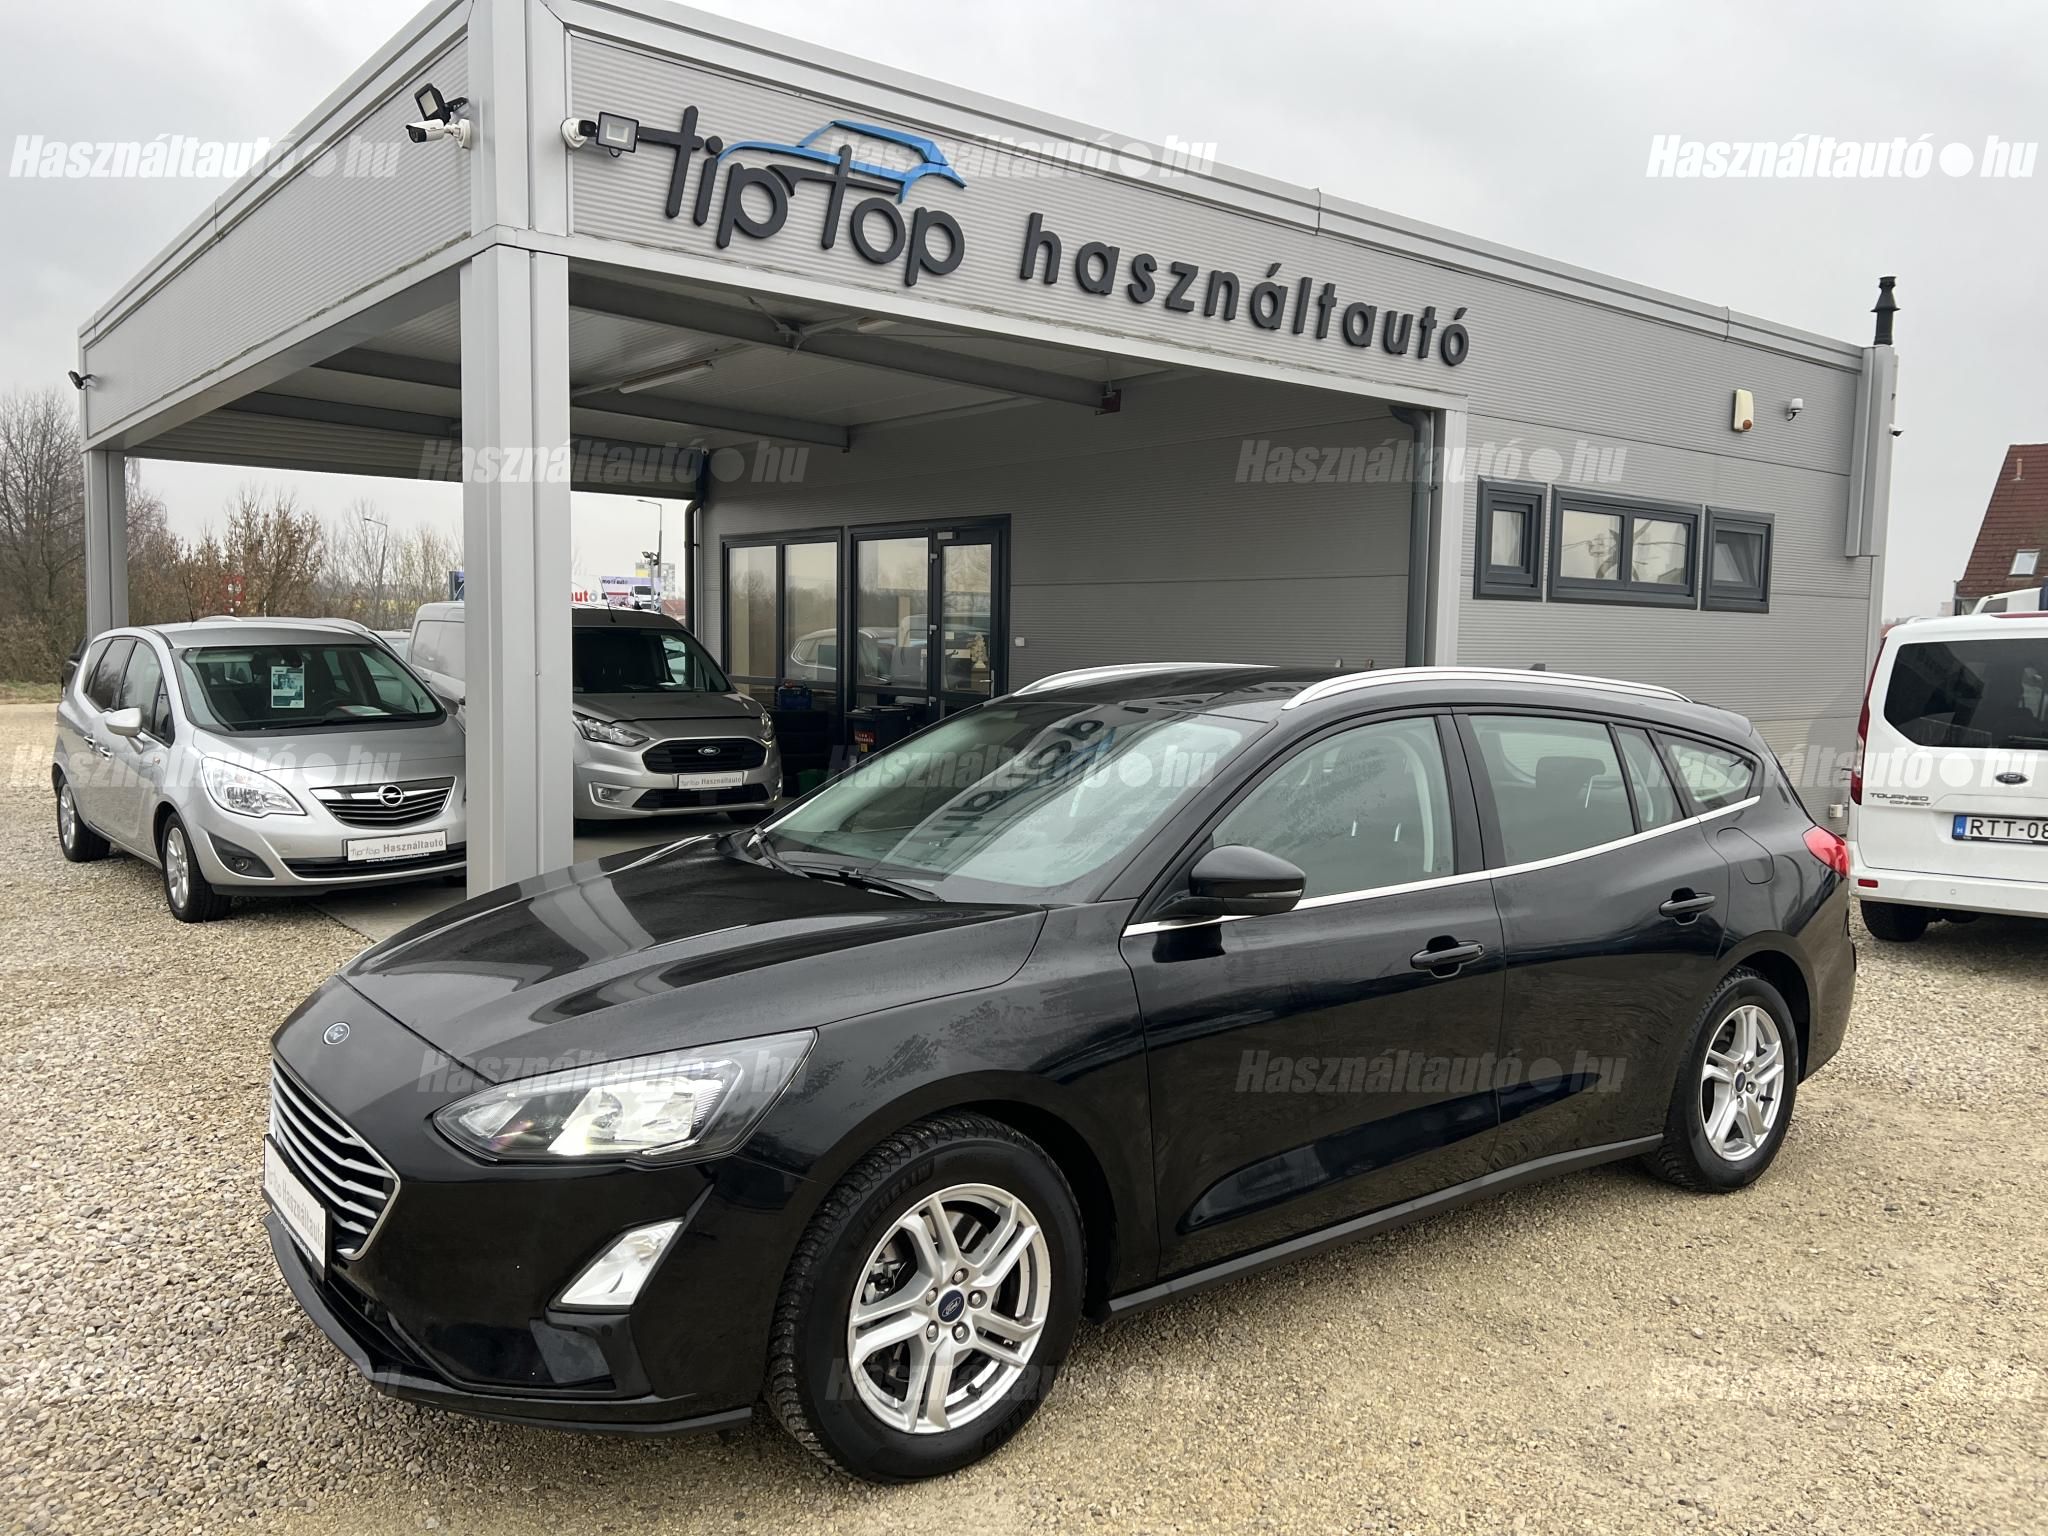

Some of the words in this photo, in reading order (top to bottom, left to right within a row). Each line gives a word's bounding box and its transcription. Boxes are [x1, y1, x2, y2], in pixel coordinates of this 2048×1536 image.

[1019, 212, 1470, 367] használtautó
[1870, 792, 1929, 802] TOURNEO
[383, 838, 444, 853] Használtautó
